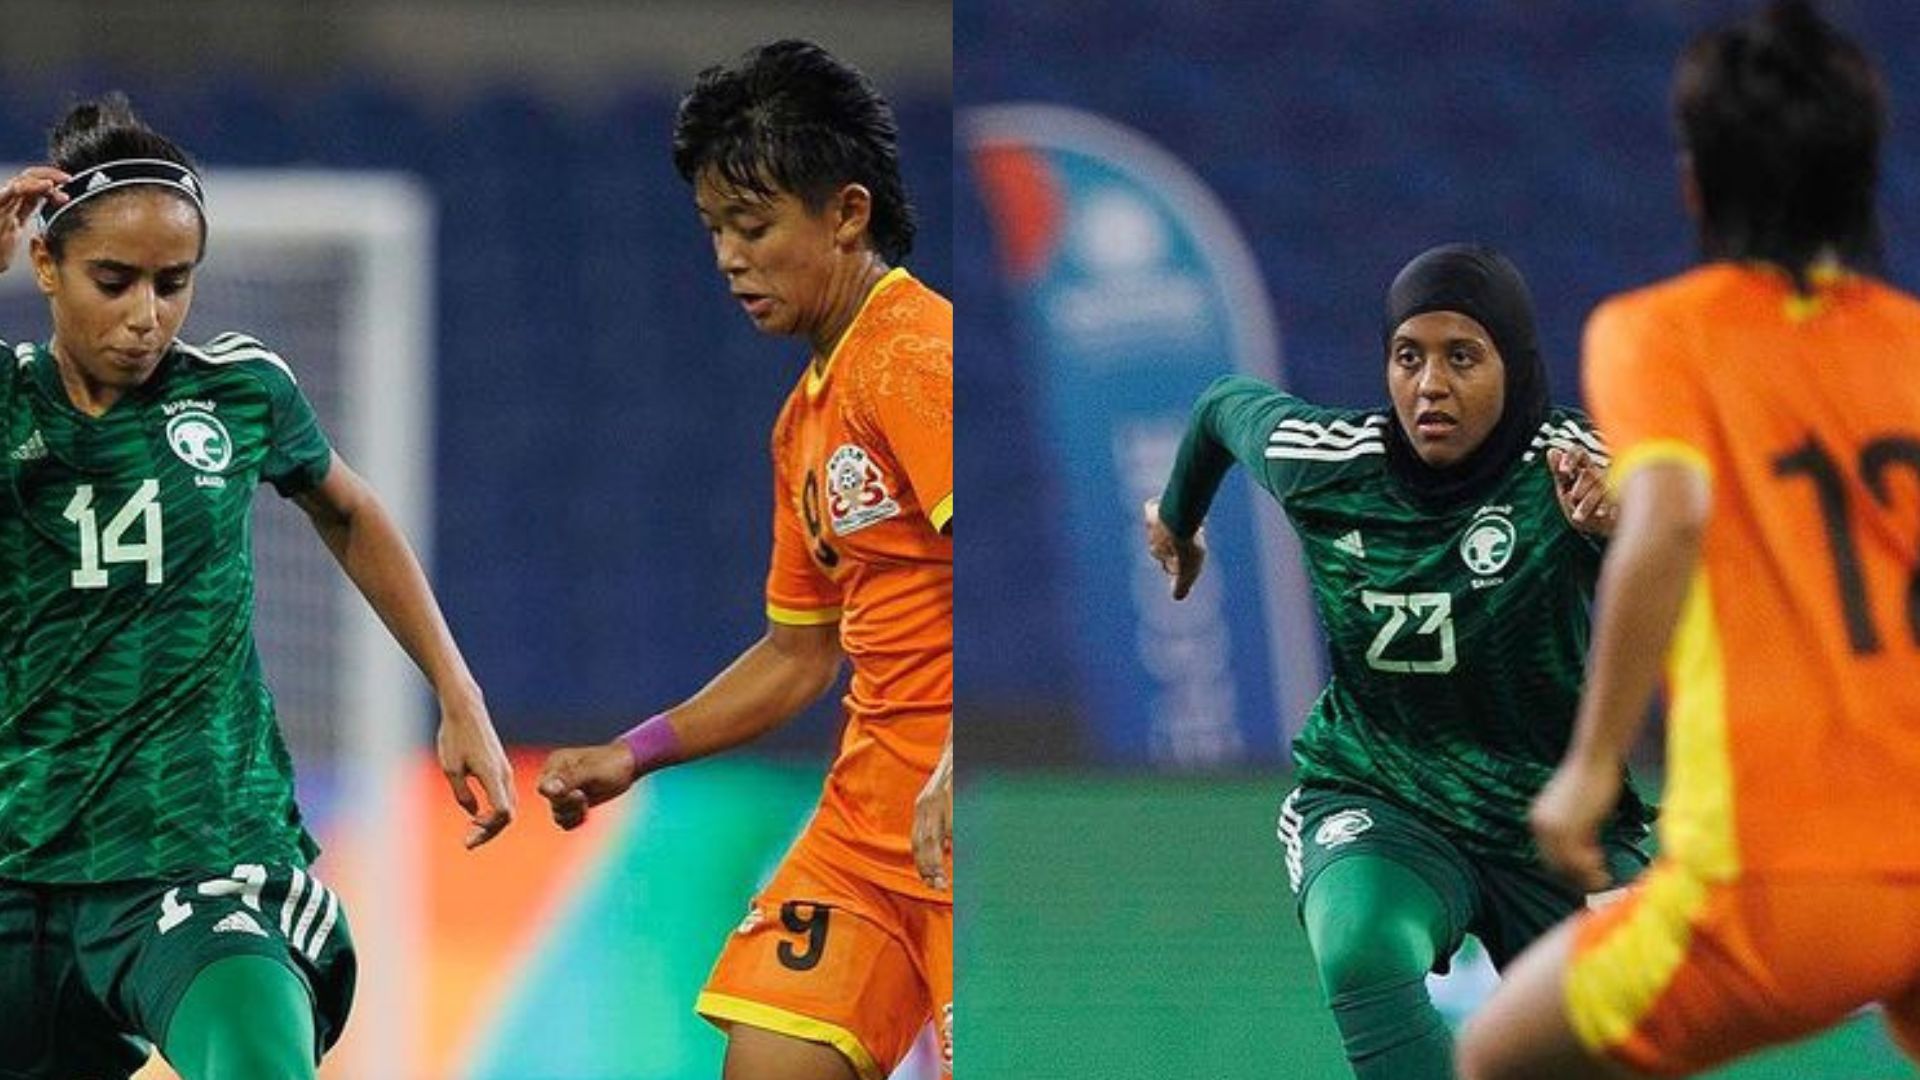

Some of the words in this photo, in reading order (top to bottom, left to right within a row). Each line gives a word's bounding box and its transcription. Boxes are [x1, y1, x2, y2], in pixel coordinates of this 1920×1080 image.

[62, 479, 164, 588] 14
[1361, 590, 1457, 673] 23
[777, 901, 830, 970] 9
